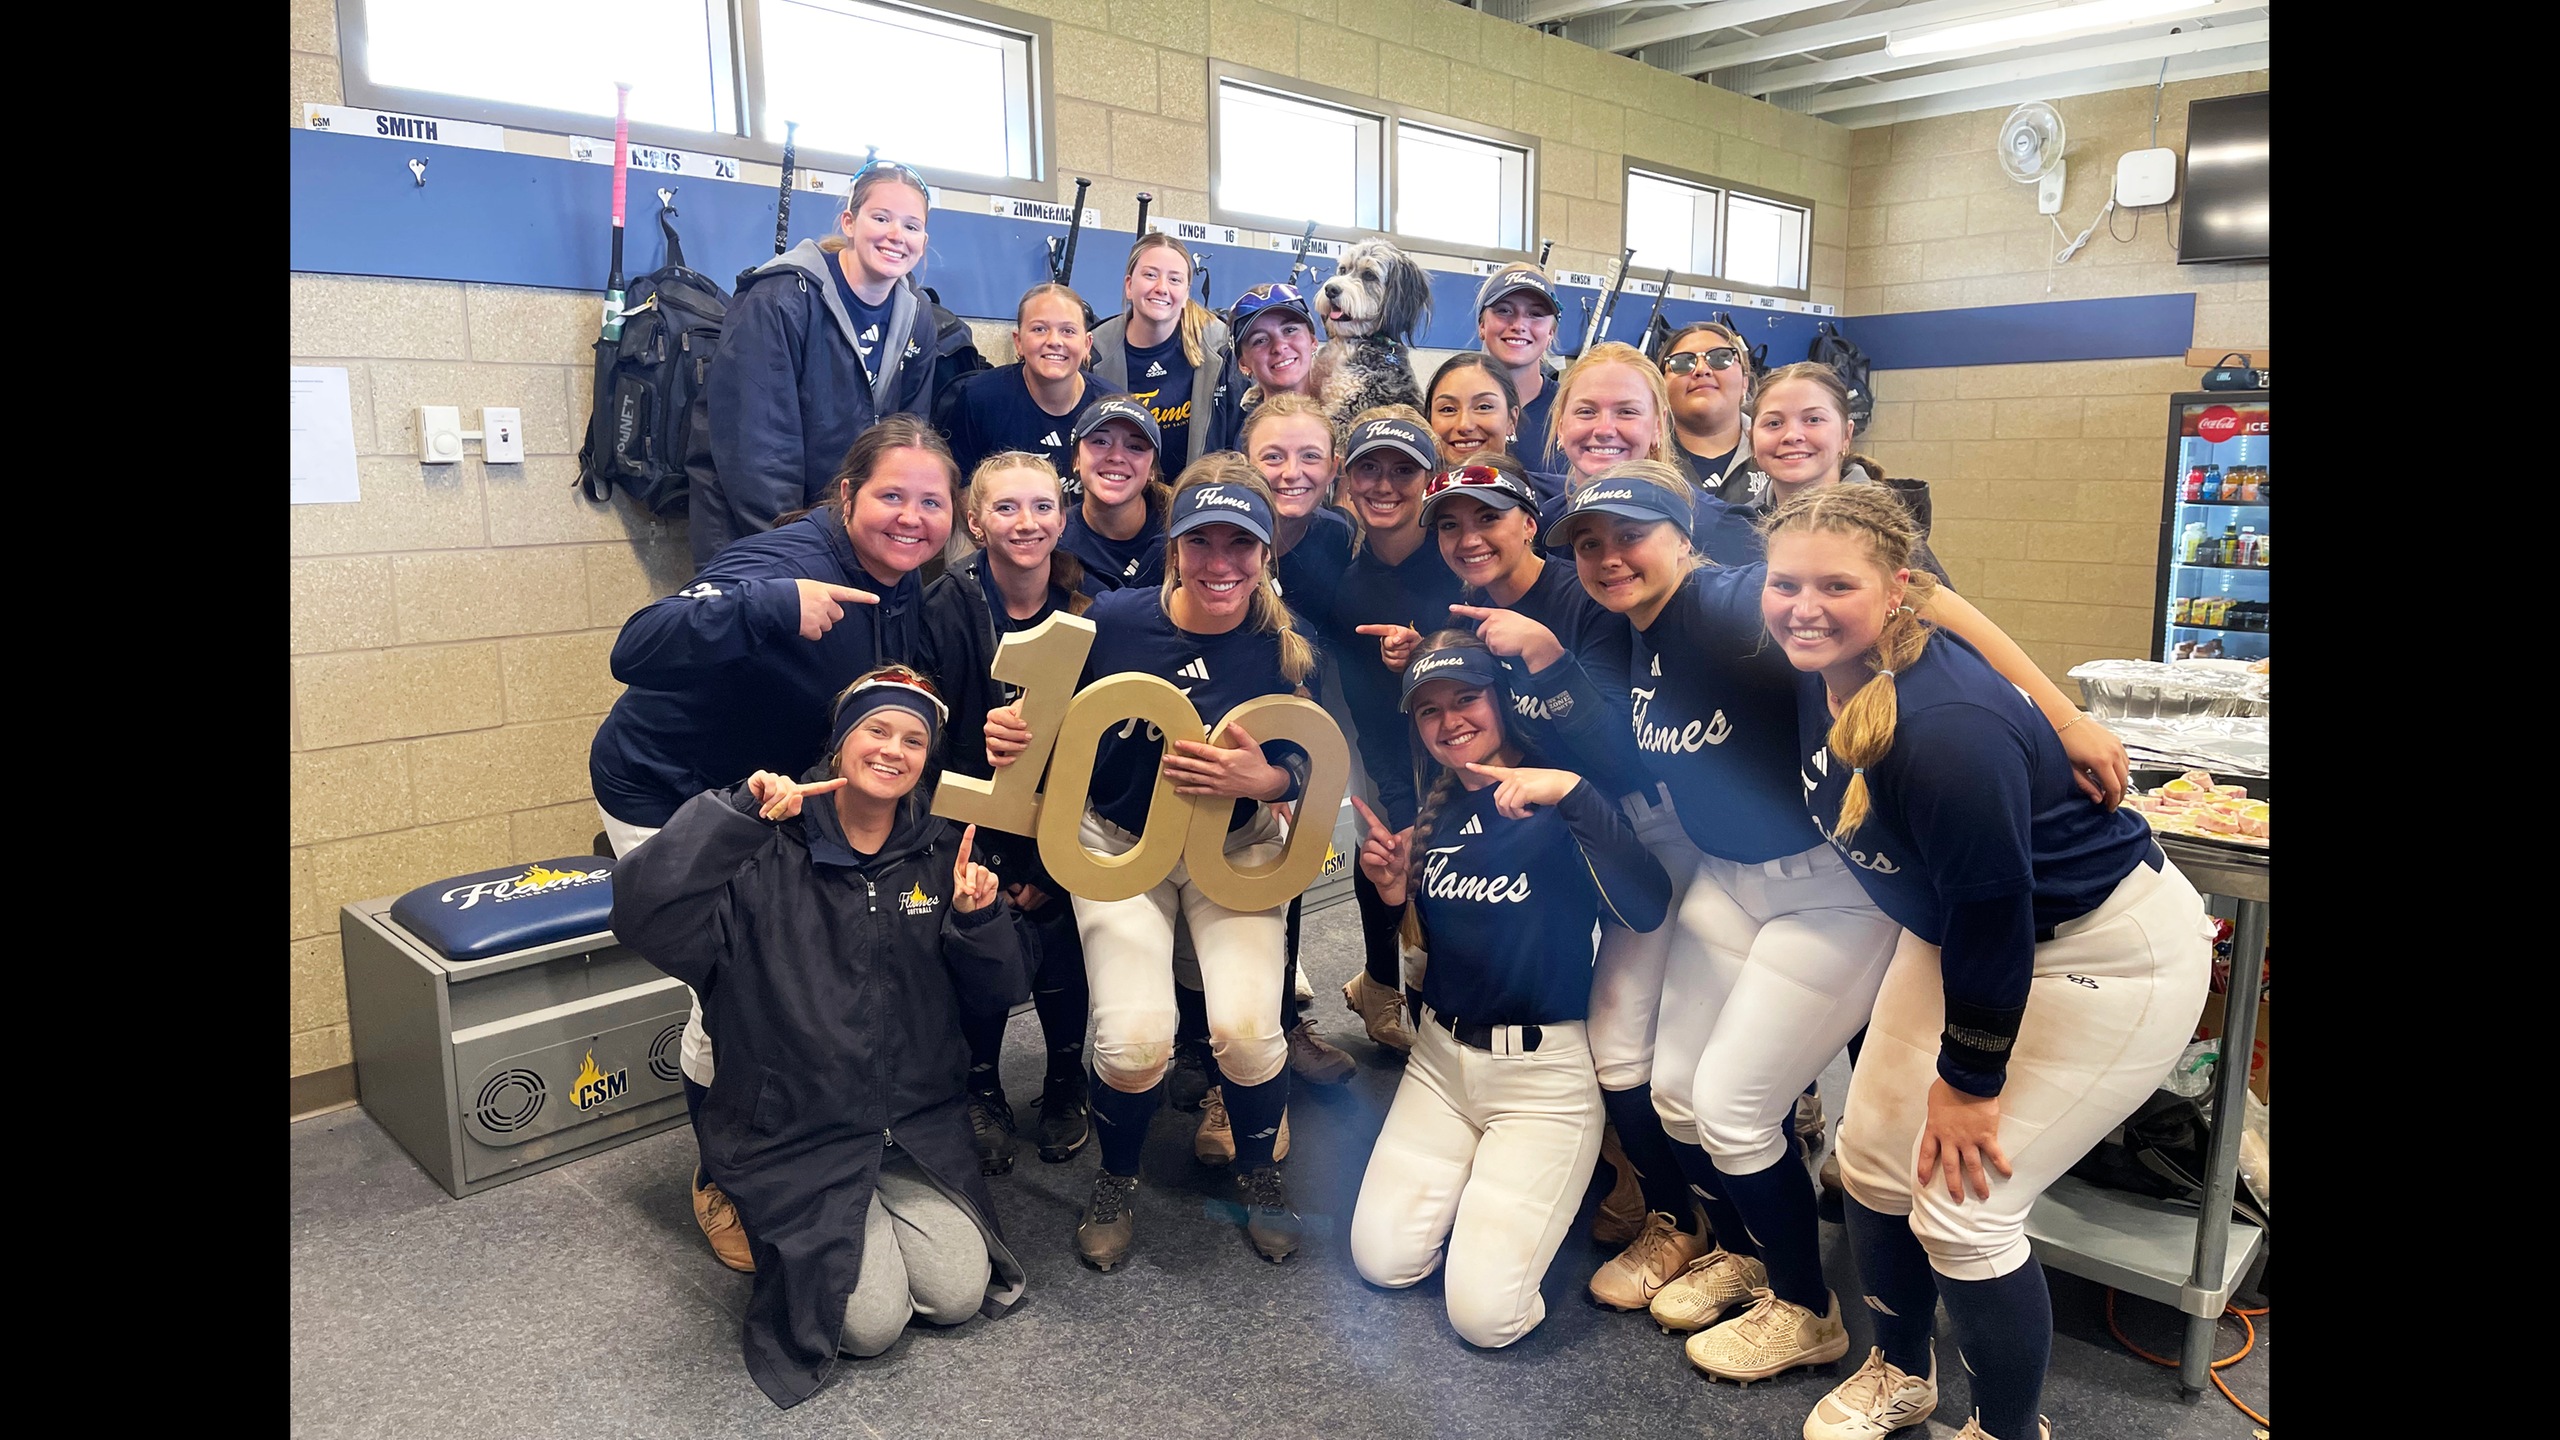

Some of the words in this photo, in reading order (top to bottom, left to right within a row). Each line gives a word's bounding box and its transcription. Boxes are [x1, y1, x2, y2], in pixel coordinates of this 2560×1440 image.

[312, 117, 330, 127] CSM
[376, 115, 438, 141] SMITH
[811, 180, 824, 189] CSM
[1012, 201, 1076, 222] ZIMMERMA
[1178, 223, 1206, 240] LYNCH
[1224, 229, 1235, 243] 16
[1504, 271, 1546, 291] Flames
[1570, 273, 1592, 286] HENSCH
[1705, 290, 1718, 300] PEREZ
[1146, 369, 1167, 378] adidas
[1100, 400, 1146, 422] Flames
[1365, 419, 1416, 442] Flames
[2245, 421, 2269, 432] ICE
[1195, 485, 1251, 512] Flames
[1575, 482, 1633, 511] Flames
[1412, 652, 1465, 681] Flames
[1630, 686, 1733, 755] Flames
[930, 609, 1352, 913] 100
[1324, 850, 1347, 878] CSM
[1421, 844, 1532, 904] Flames
[441, 868, 612, 911] Flame
[898, 890, 940, 911] Flames
[907, 905, 933, 916] SOFTBALL
[578, 1067, 629, 1112] CSM
